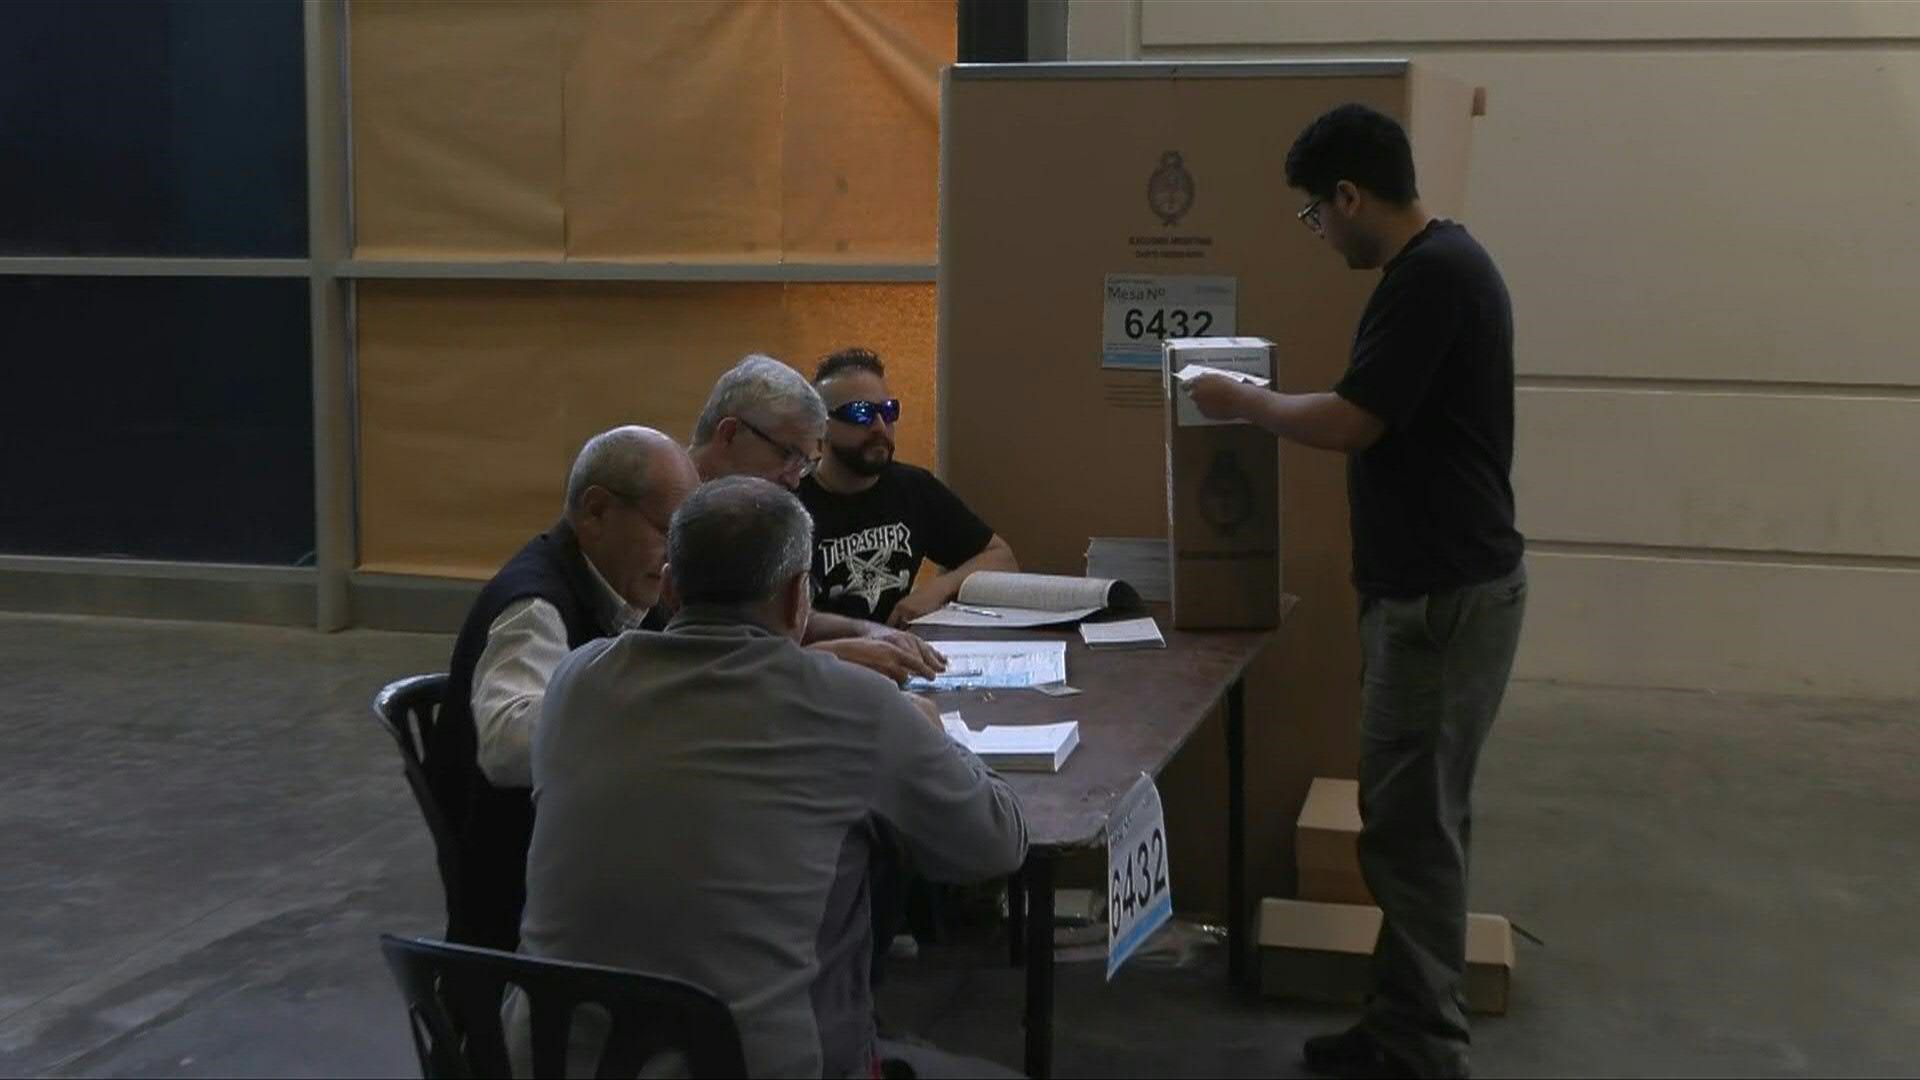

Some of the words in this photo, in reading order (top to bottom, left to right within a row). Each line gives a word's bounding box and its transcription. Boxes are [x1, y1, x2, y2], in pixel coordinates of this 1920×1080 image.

[1108, 286, 1144, 300] Mesa
[1124, 308, 1214, 339] 6432
[818, 521, 912, 576] THRASHER
[1111, 828, 1166, 938] 6432
